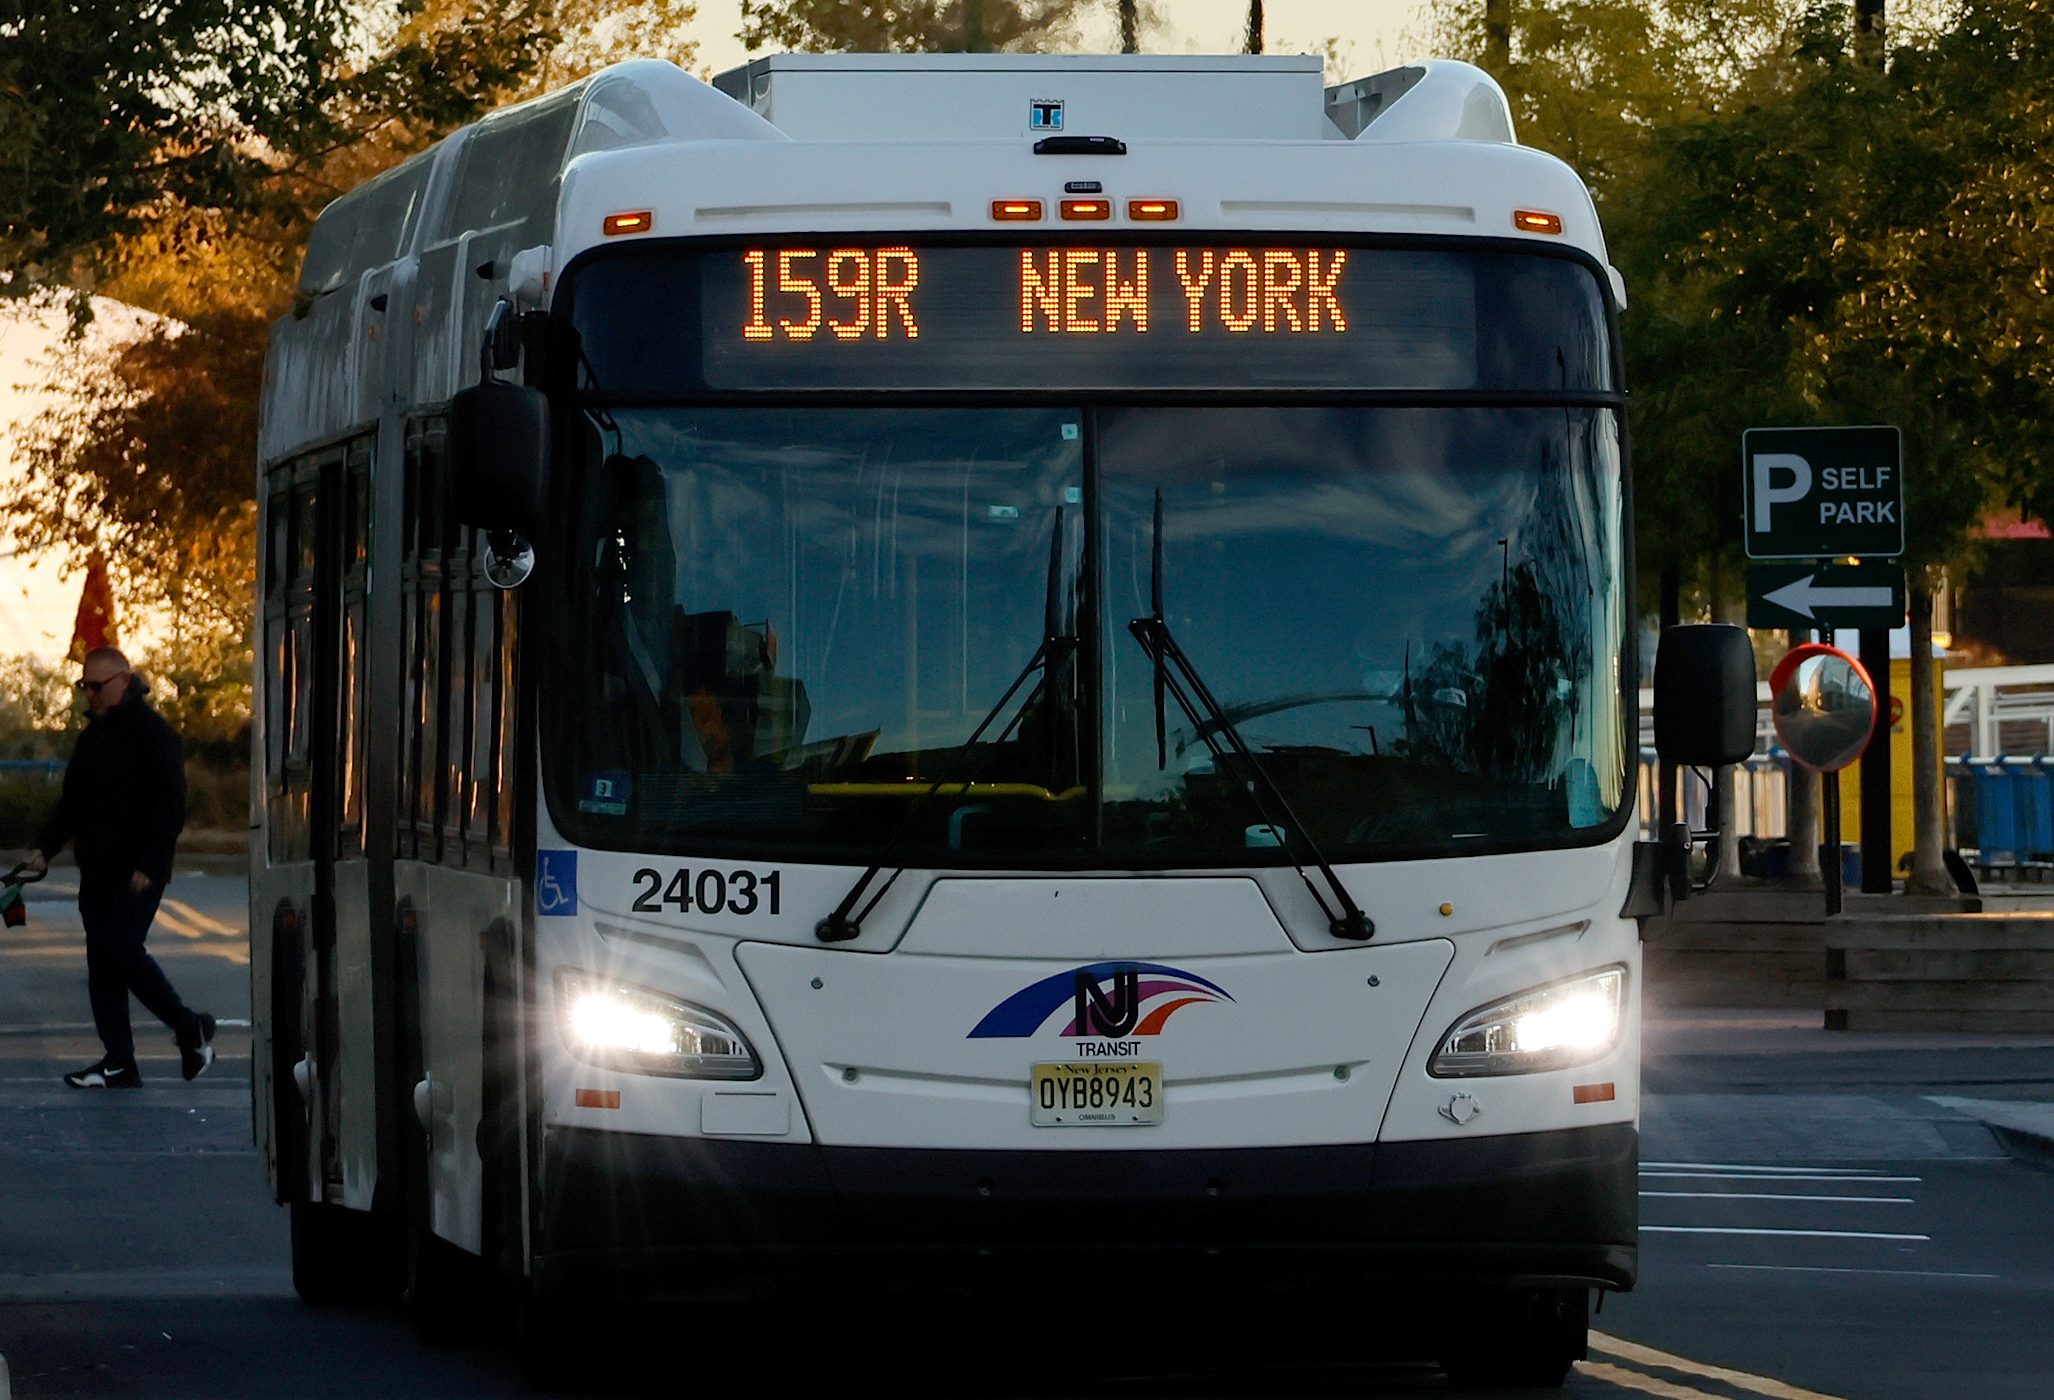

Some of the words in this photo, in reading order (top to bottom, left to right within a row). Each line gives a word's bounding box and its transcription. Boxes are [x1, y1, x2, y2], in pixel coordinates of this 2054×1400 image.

[744, 248, 919, 339] 159R
[1021, 250, 1148, 333] NEW
[1175, 250, 1346, 333] YORK
[1753, 453, 1813, 533] P
[1821, 467, 1891, 490] SELF
[1819, 501, 1896, 525] PARK
[632, 868, 781, 916] 24031
[1075, 966, 1139, 1038] NJ
[1076, 1041, 1142, 1057] TRANSIT
[1064, 1064, 1090, 1075] New
[1094, 1063, 1129, 1076] Jersey
